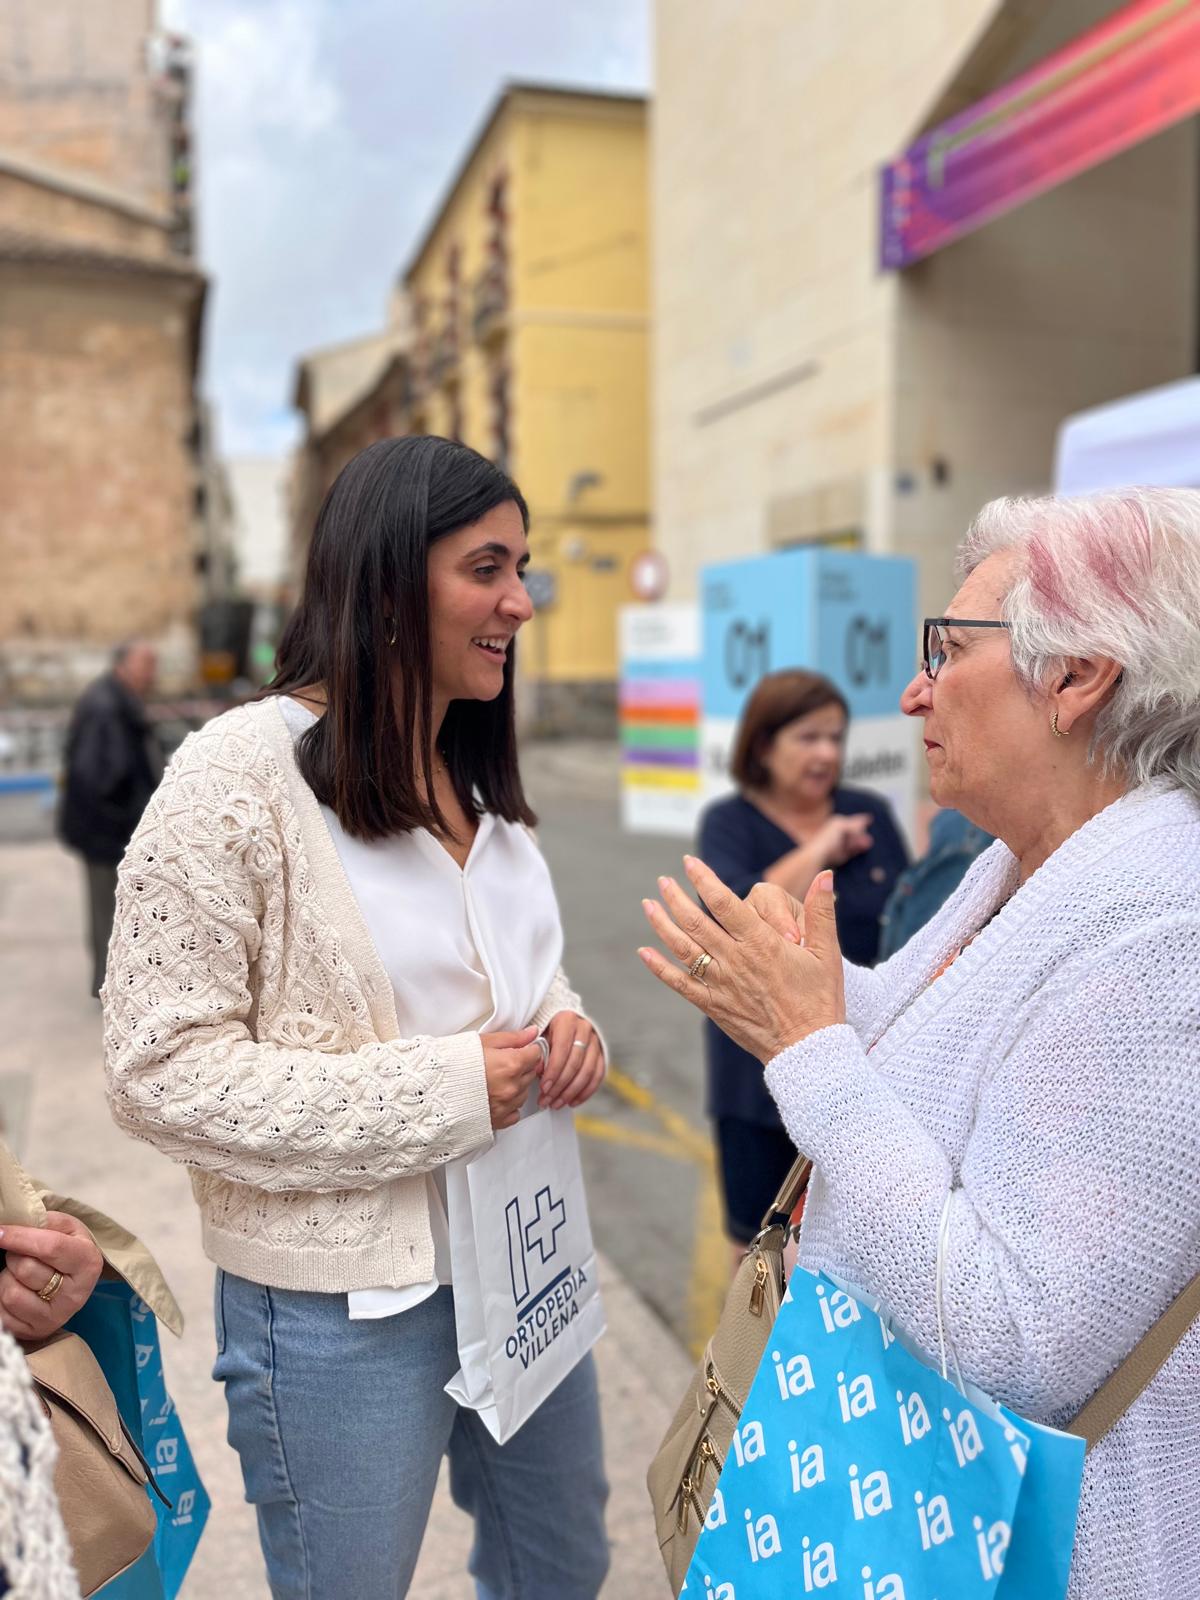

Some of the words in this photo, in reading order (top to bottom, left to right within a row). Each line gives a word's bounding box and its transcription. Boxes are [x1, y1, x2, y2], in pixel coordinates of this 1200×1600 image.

[505, 1267, 588, 1359] ORTOPEDIA
[519, 1300, 579, 1370] VILLENA
[816, 1284, 861, 1333] ia
[772, 1351, 816, 1400] ia
[837, 1371, 877, 1424] ia
[896, 1390, 932, 1446] ia
[943, 1407, 985, 1468] ia
[151, 1438, 178, 1475] ia
[788, 1440, 826, 1493] ia
[172, 1489, 196, 1527] ia
[848, 1464, 893, 1521] ia
[914, 1490, 954, 1551] ia
[744, 1508, 782, 1563] ia
[973, 1515, 1012, 1581] ia
[802, 1536, 838, 1593] ia
